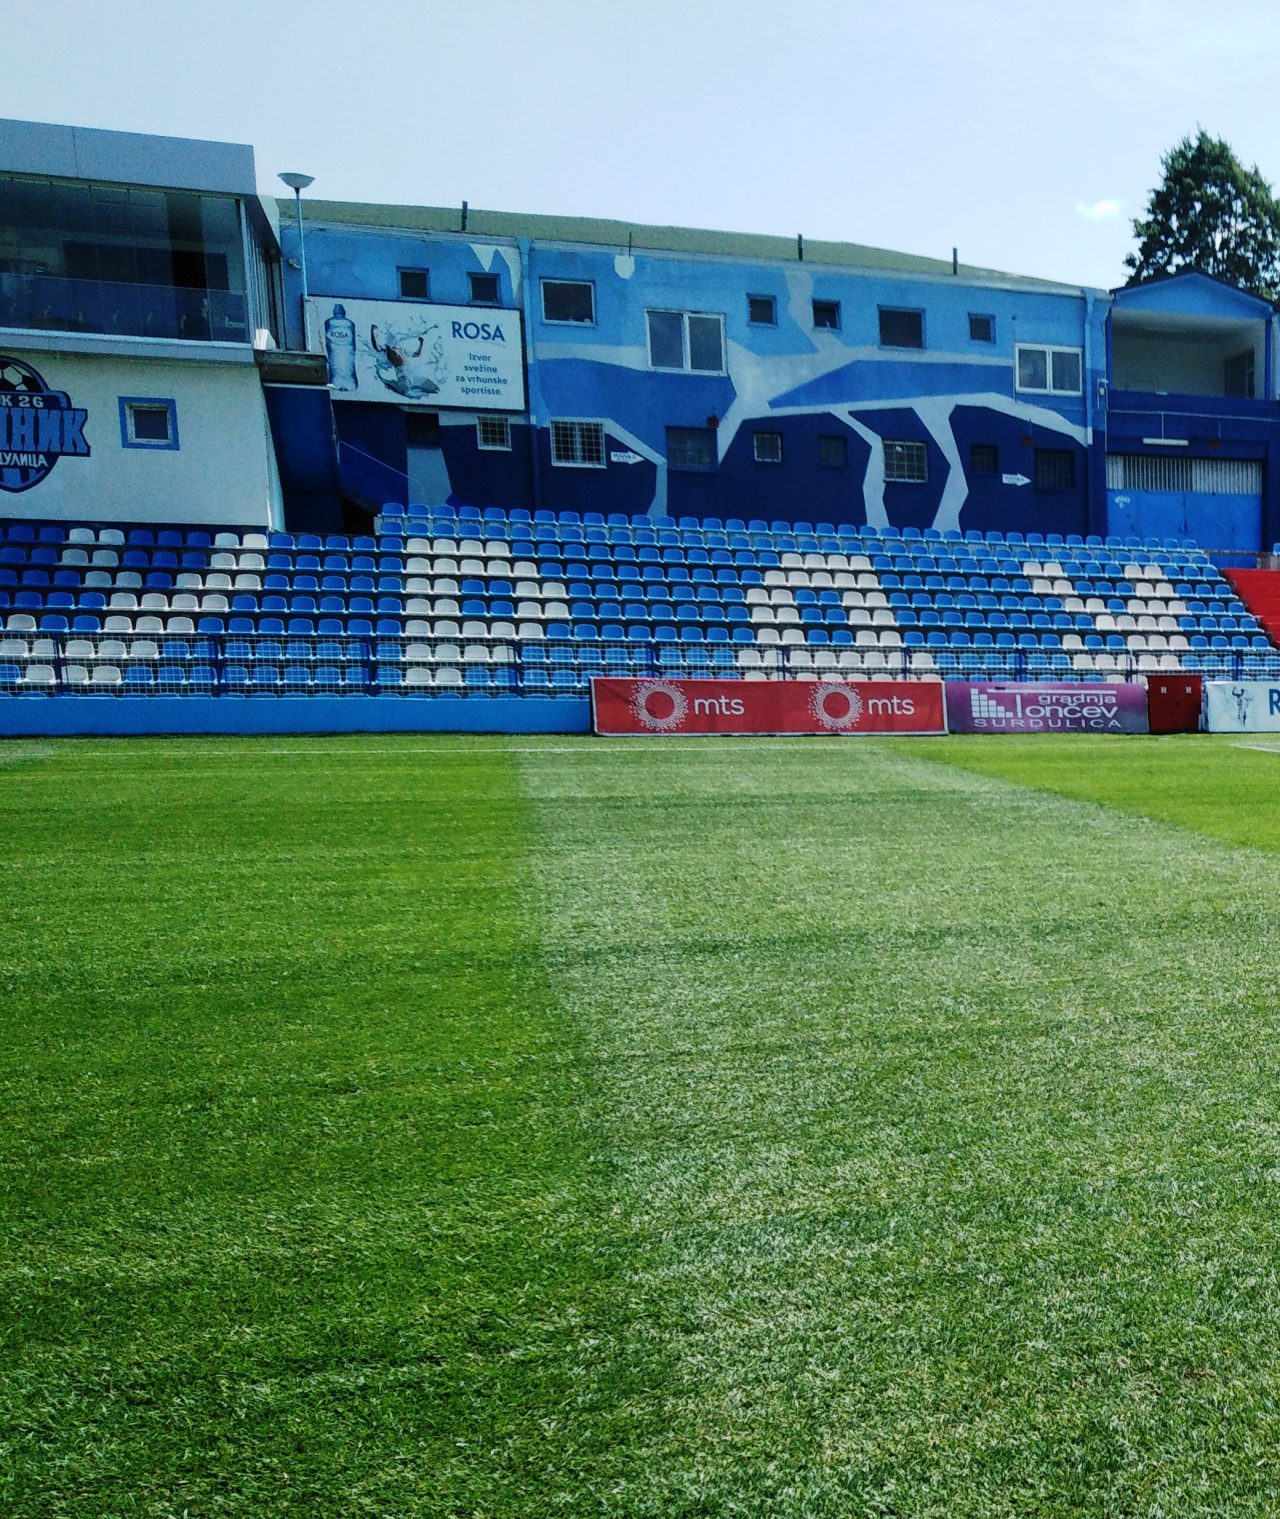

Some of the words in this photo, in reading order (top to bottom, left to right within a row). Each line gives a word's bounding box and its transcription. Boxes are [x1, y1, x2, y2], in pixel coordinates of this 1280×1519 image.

[451, 321, 506, 342] ROSA
[469, 353, 491, 361] Izvor
[464, 364, 498, 373] svežine
[467, 376, 508, 384] vrhunske
[18, 396, 44, 408] 26
[0, 407, 88, 453] НИК
[694, 695, 745, 715] mts
[868, 695, 915, 715] mts
[1038, 694, 1116, 706] gradnja
[974, 718, 1122, 728] SURDULICA
